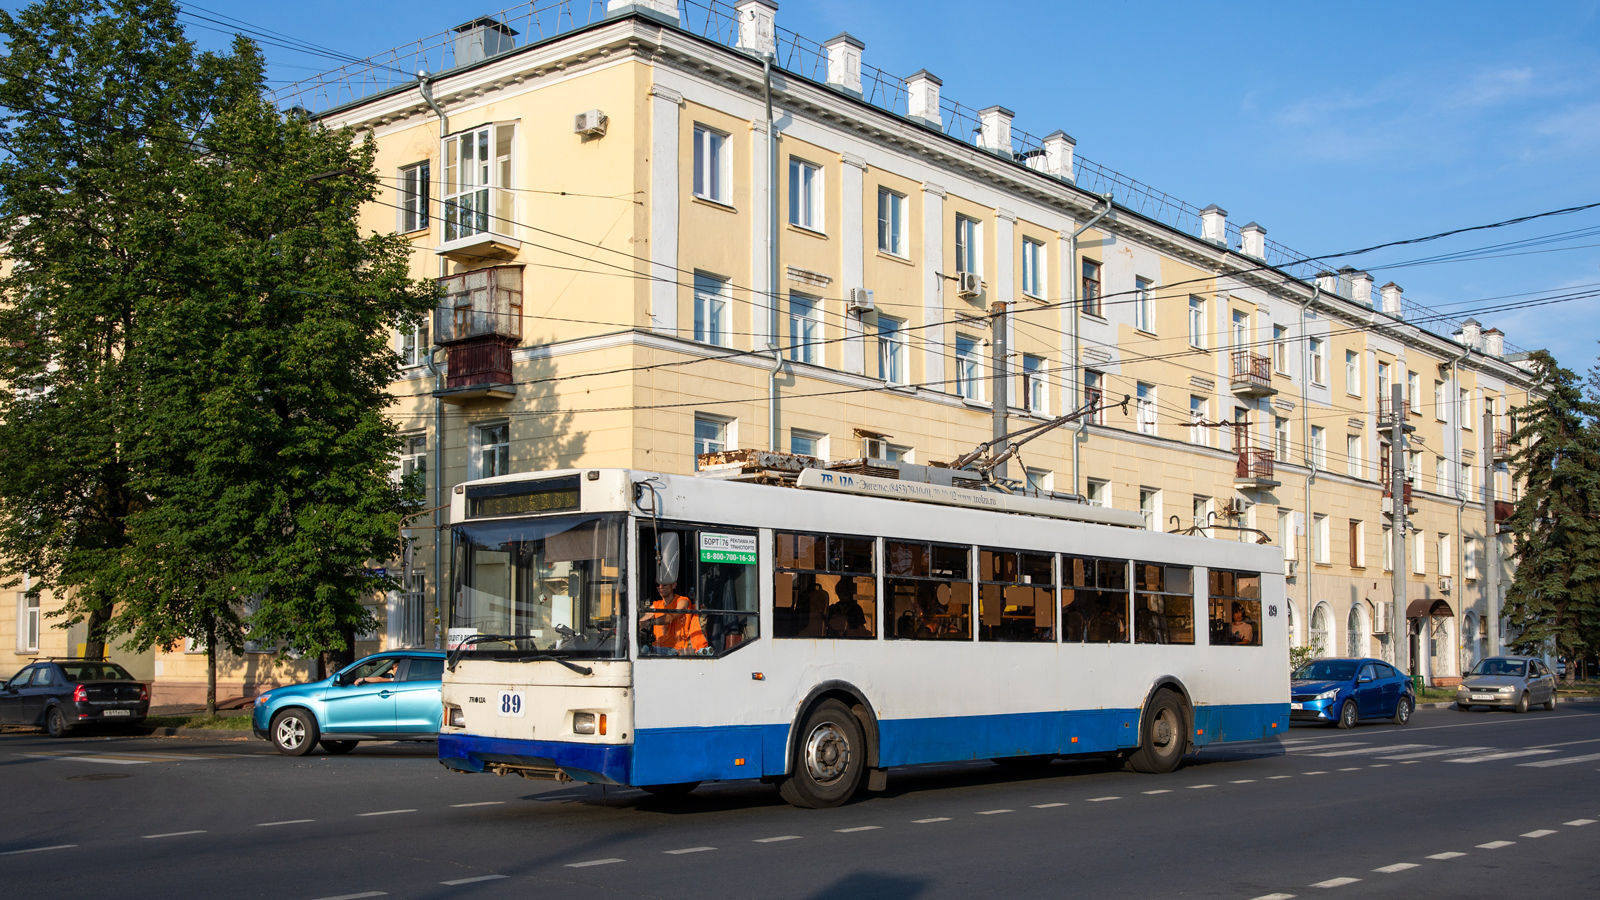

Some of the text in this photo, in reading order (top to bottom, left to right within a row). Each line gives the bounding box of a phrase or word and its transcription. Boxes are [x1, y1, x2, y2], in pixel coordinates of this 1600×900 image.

[704, 537, 729, 547] БОРТ 76
[706, 552, 756, 562] 8-800-700-16-36
[1268, 604, 1278, 617] 89
[501, 693, 522, 714] 89
